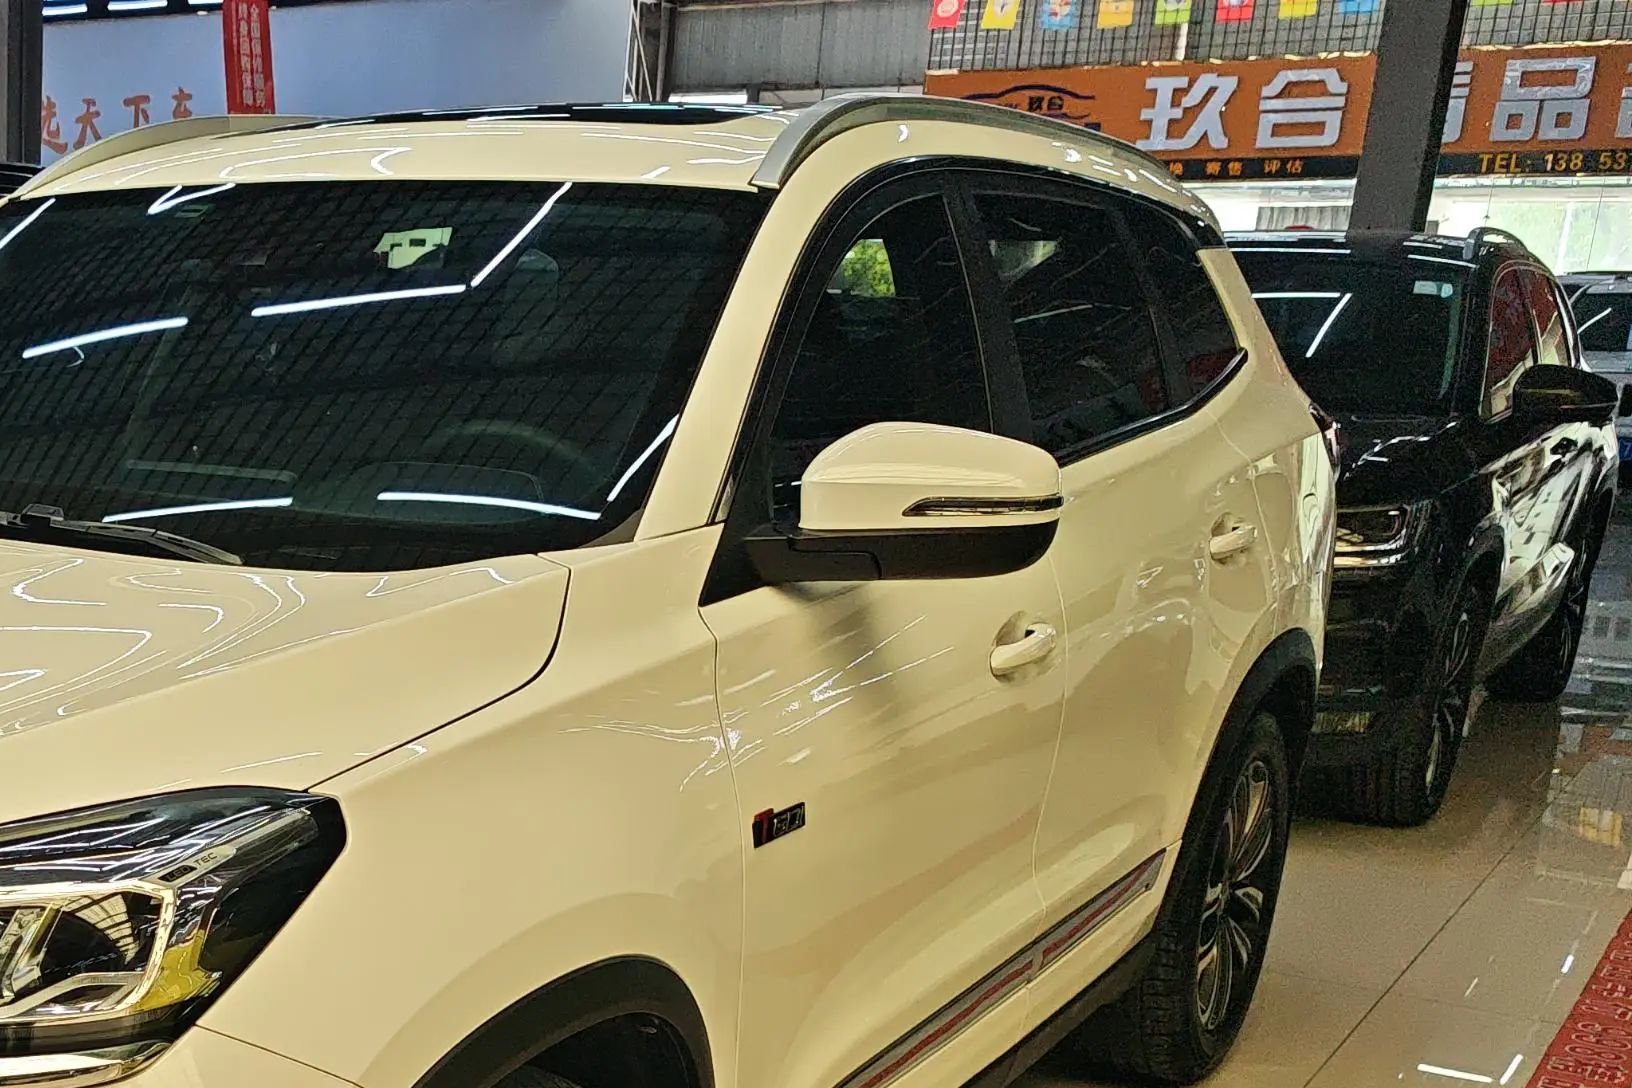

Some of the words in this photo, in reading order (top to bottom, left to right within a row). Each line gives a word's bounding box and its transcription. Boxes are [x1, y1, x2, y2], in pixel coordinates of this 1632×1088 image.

[1264, 159, 1304, 175] 评估
[1479, 153, 1531, 173] TEL:
[1544, 152, 1584, 173] 138
[1599, 151, 1632, 171] 53
